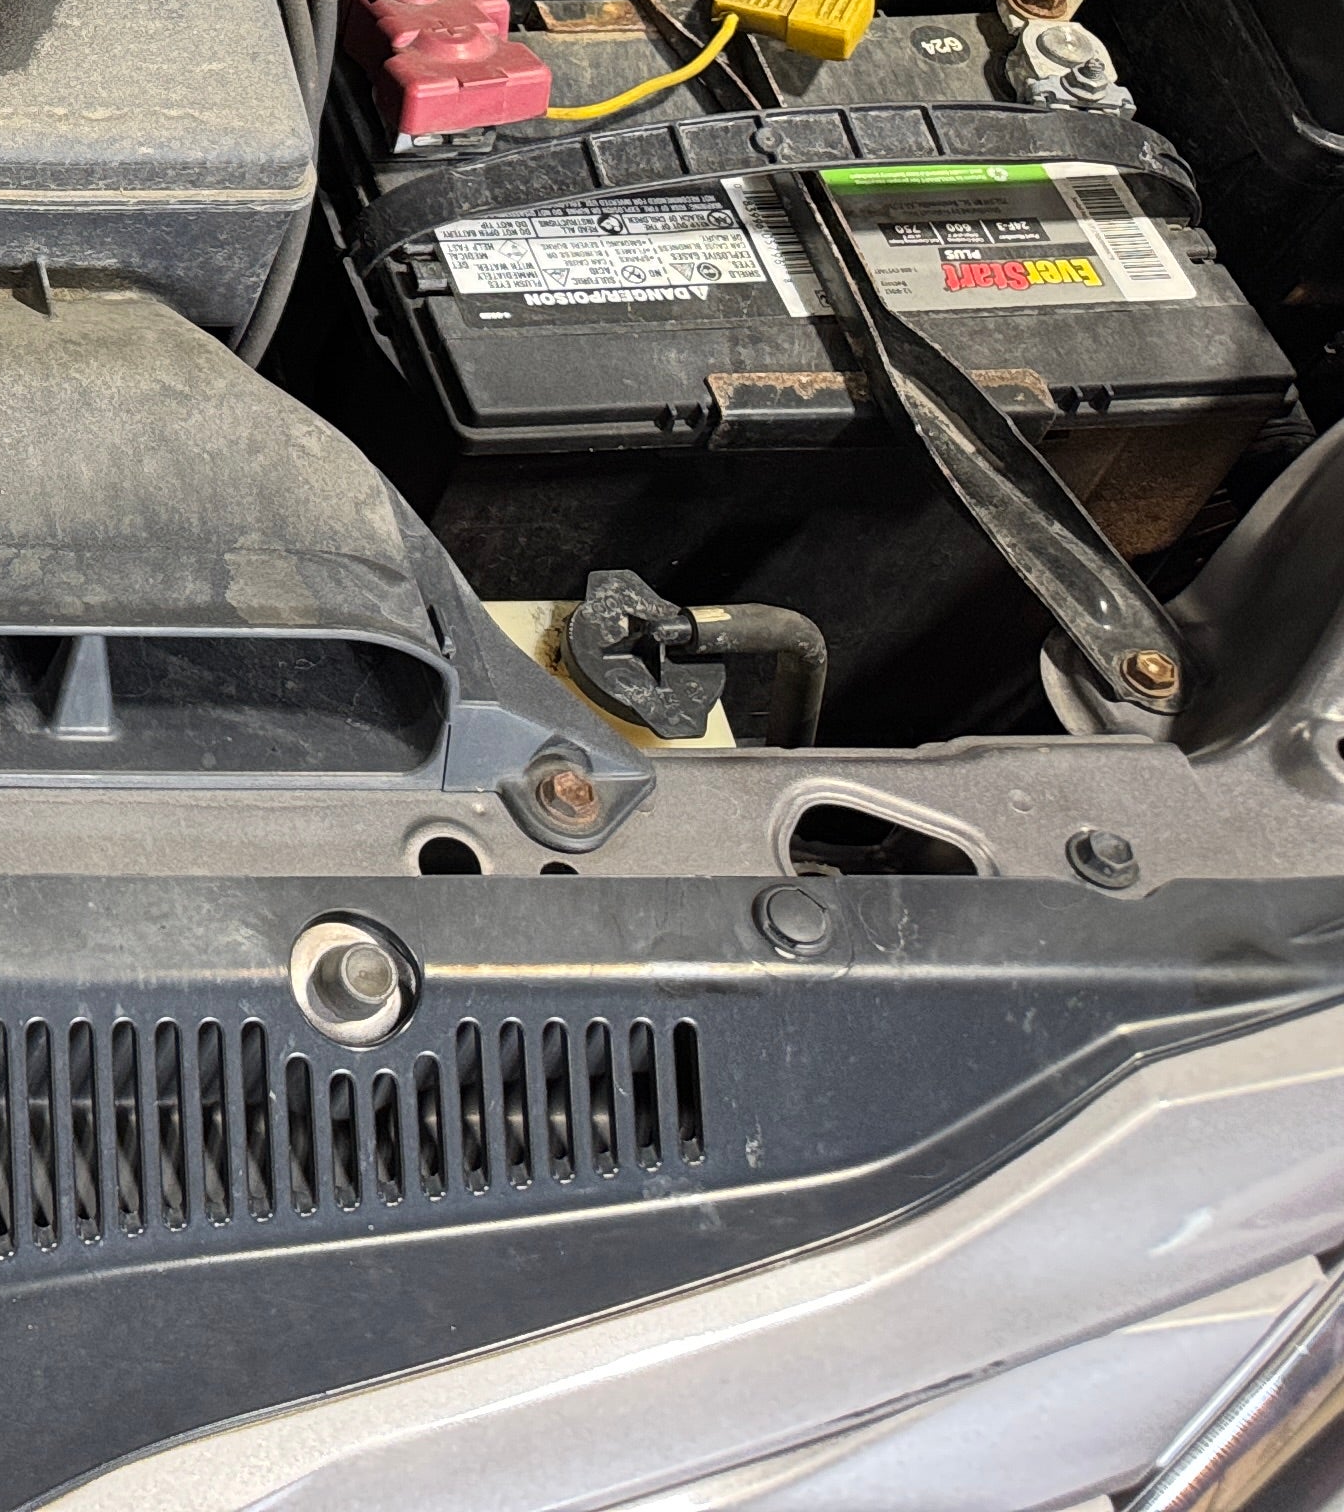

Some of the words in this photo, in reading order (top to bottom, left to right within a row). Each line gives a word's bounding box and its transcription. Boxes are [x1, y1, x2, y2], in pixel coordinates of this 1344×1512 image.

[894, 224, 921, 234] 750
[945, 223, 972, 233] 600
[996, 221, 1030, 231] 24F-3
[944, 248, 981, 261] PLUS
[941, 258, 1102, 292] EverStart
[524, 287, 691, 306] DANGER/POISON
